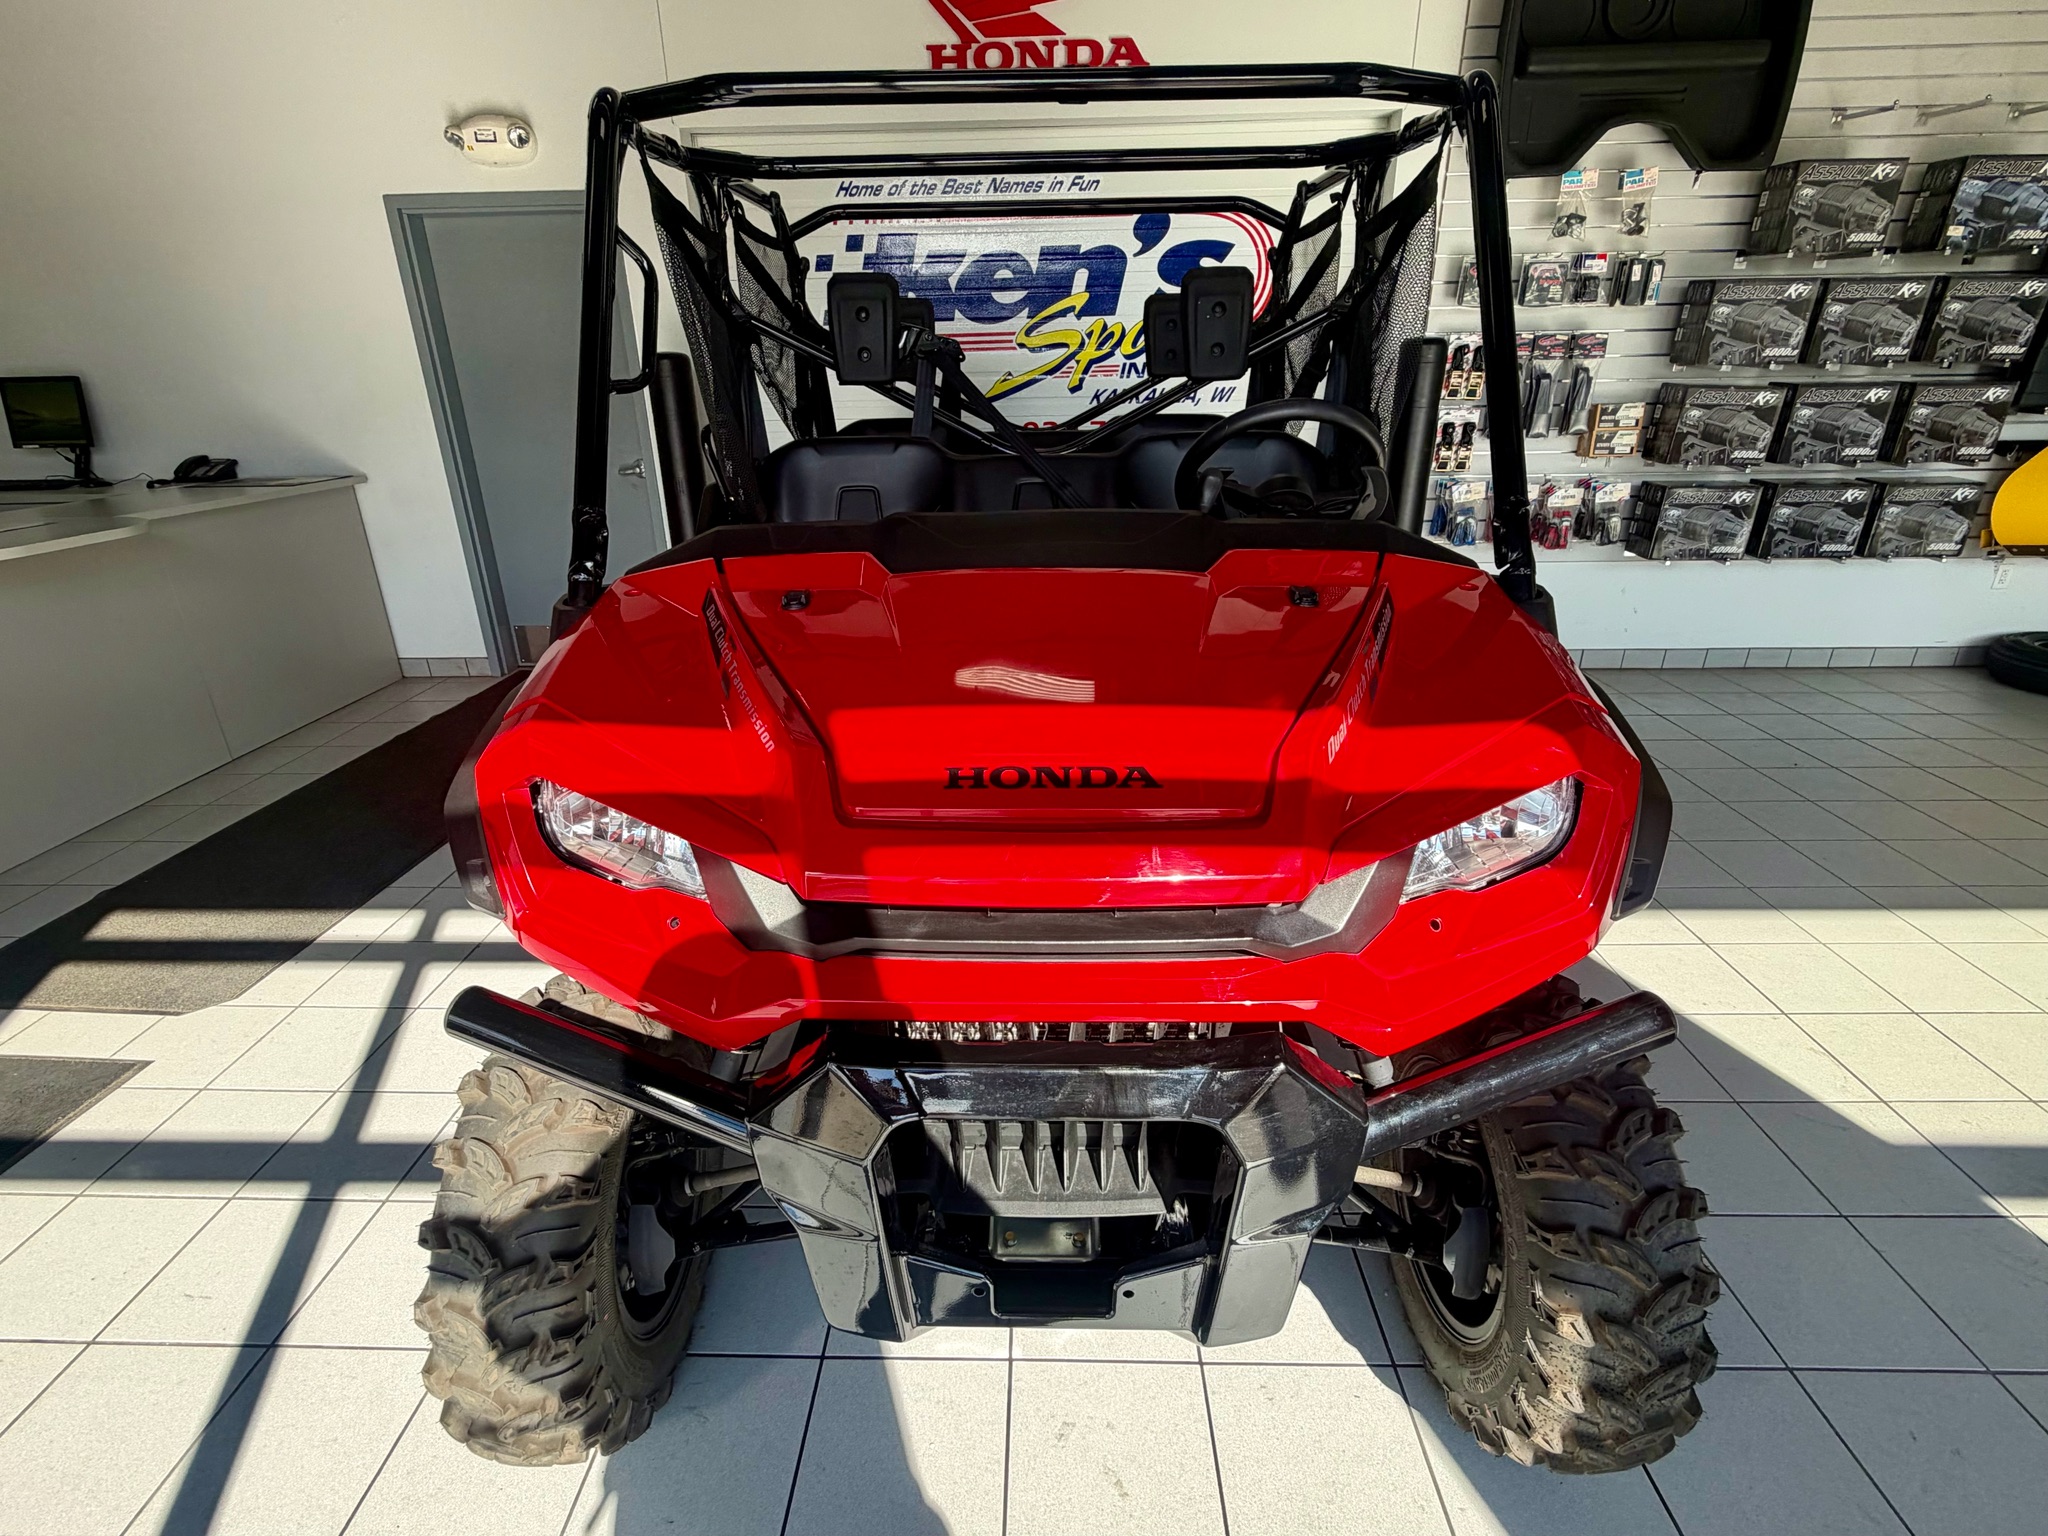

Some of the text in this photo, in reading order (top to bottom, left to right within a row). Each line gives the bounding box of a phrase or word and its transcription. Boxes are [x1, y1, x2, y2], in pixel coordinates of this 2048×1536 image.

[926, 37, 1150, 69] HONDA
[1799, 163, 1875, 180] ASSAULT
[1964, 159, 2045, 177] ASSAULT
[835, 175, 1100, 198] Home of the Best Names in Fun
[1713, 283, 1787, 300] ASSAULT
[1828, 282, 1902, 299] ASSAULT
[1948, 280, 2023, 296] ASSAULT
[1210, 386, 1237, 403] WI
[1687, 388, 1756, 405] ASSAULT
[1797, 388, 1867, 403] ASSAULT
[1914, 386, 1986, 402] ASSAULT
[1666, 490, 1732, 504] ASSAULT
[1777, 488, 1845, 503] ASSAULT
[1885, 487, 1955, 501] ASSAULT
[706, 603, 776, 752] Dual Clutch Transmission
[1327, 602, 1392, 765] Dual Clutch Transmission
[943, 766, 1164, 790] HONDA
